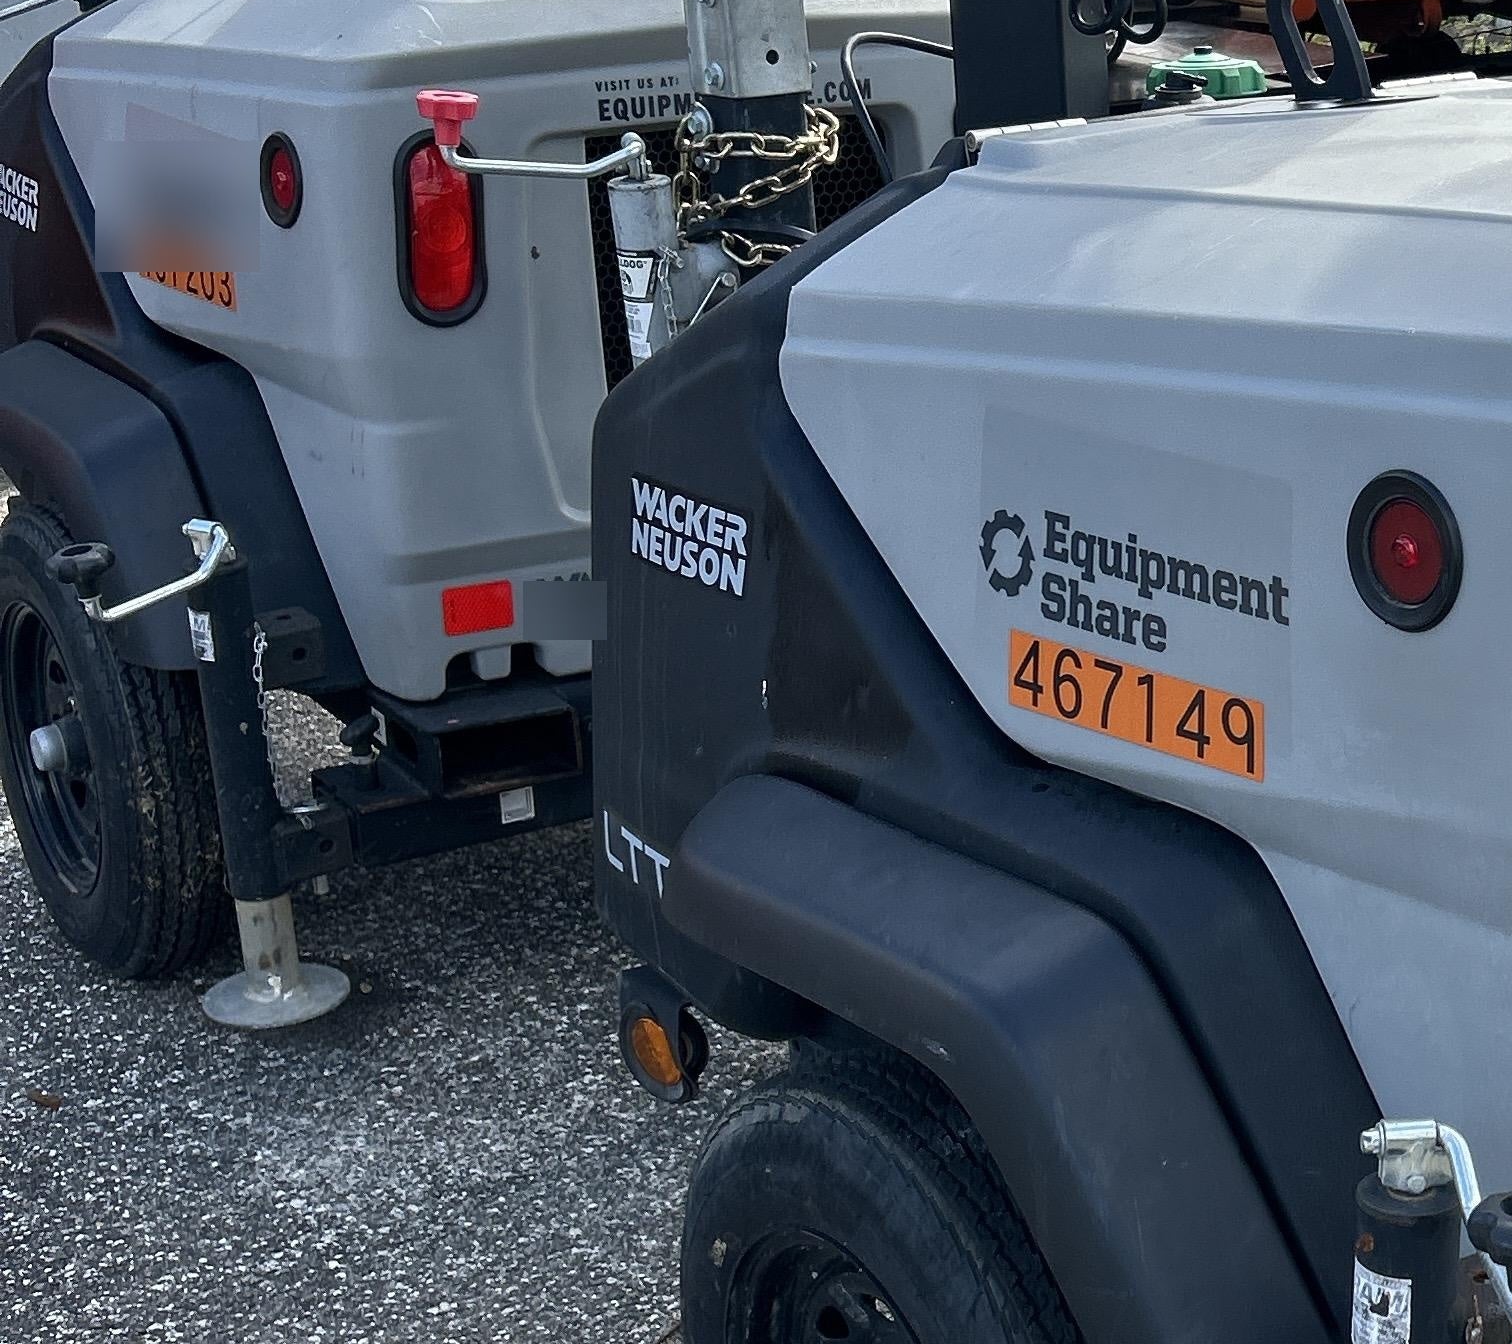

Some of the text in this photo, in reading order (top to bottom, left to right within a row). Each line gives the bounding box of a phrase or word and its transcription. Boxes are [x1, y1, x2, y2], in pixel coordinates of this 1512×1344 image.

[594, 75, 681, 93] VISIT US AT:
[0, 163, 39, 207] ACKER
[631, 477, 748, 557] WACKER
[631, 517, 748, 597] NEUSON
[1043, 509, 1291, 627] Equipment
[1040, 572, 1168, 654] Share
[1012, 639, 1258, 775] 467149
[603, 810, 671, 899] LTT
